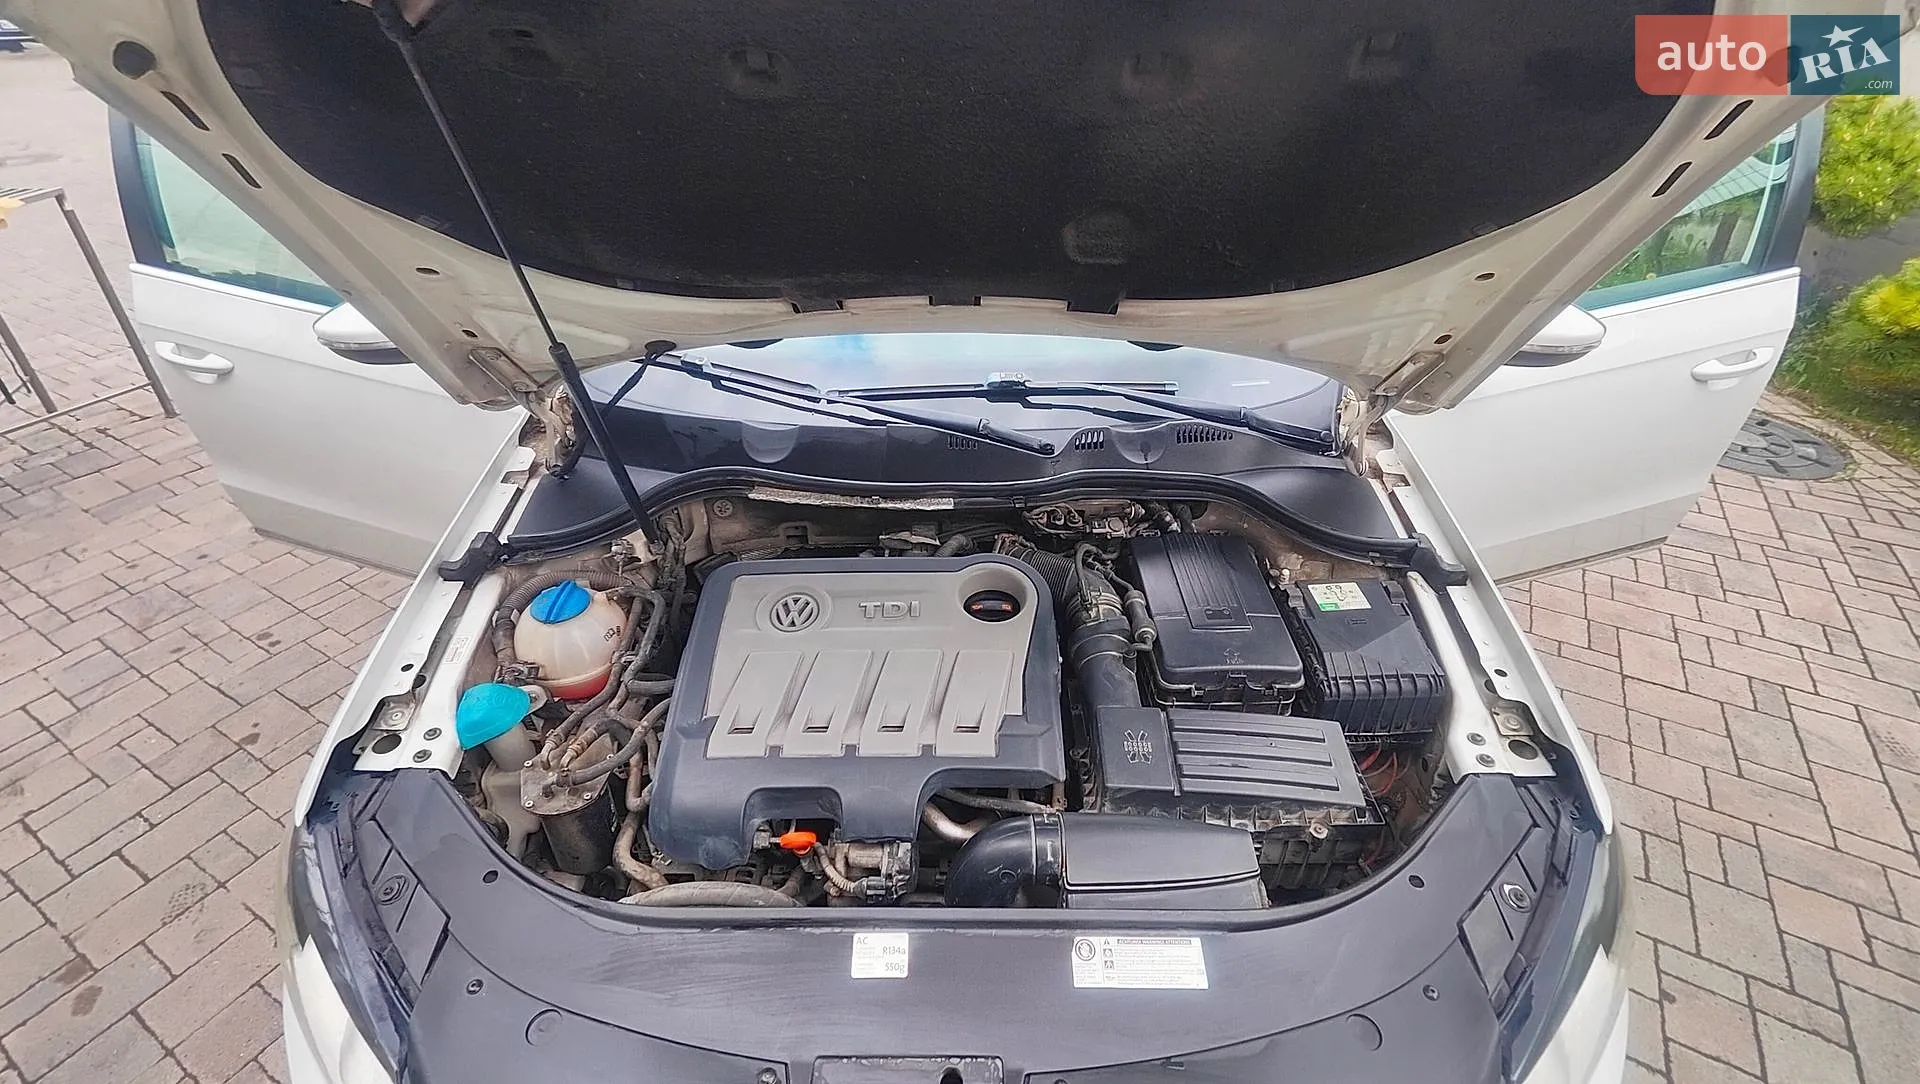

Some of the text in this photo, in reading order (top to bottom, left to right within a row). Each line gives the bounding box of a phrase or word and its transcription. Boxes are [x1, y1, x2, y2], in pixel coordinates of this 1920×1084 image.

[859, 601, 921, 618] TDI
[856, 936, 869, 945] AC
[882, 946, 906, 955] R134a
[885, 962, 905, 974] 550g
